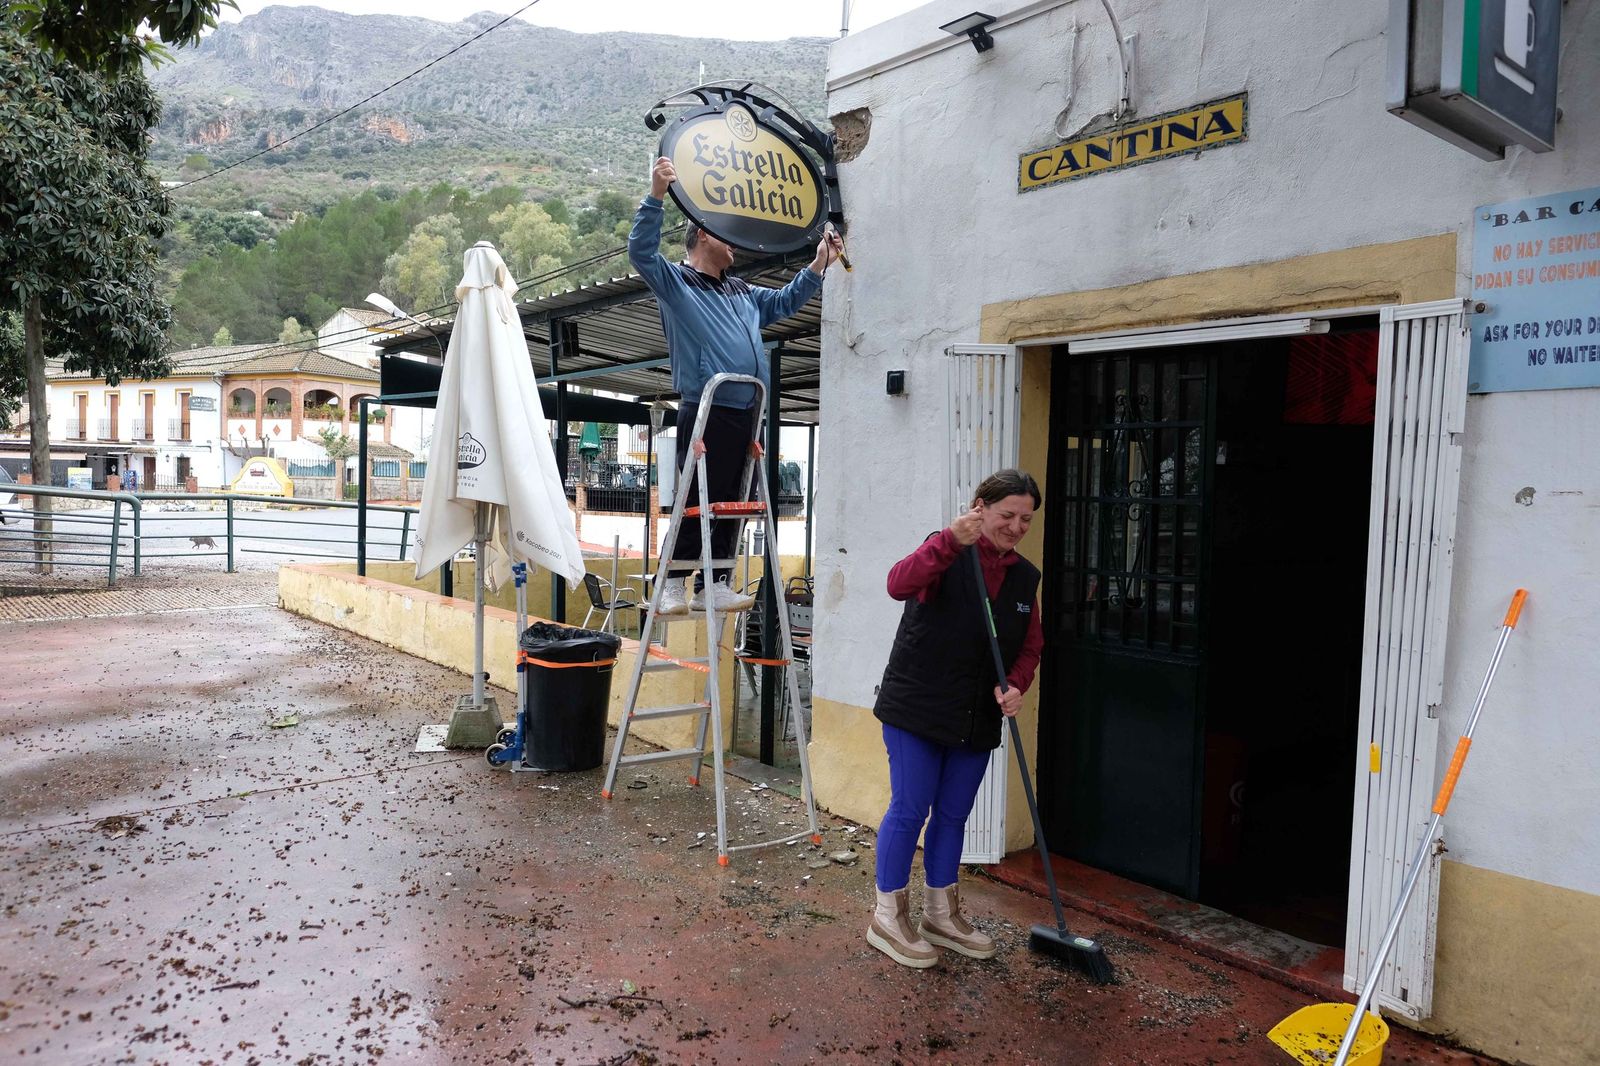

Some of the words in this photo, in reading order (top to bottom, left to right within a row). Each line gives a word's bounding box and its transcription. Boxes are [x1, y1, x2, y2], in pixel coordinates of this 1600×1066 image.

[1028, 109, 1236, 181] CANTINA
[692, 132, 804, 188] Estrella
[702, 169, 804, 220] Galicia
[1492, 206, 1557, 228] BAR
[1493, 243, 1512, 263] NO
[1516, 239, 1543, 259] HAY
[1475, 270, 1513, 290] PIDAN
[1517, 267, 1534, 286] SU
[1484, 325, 1509, 343] ASK
[1513, 321, 1540, 340] FOR
[1545, 317, 1582, 338] YOUR
[1527, 348, 1547, 366] NO
